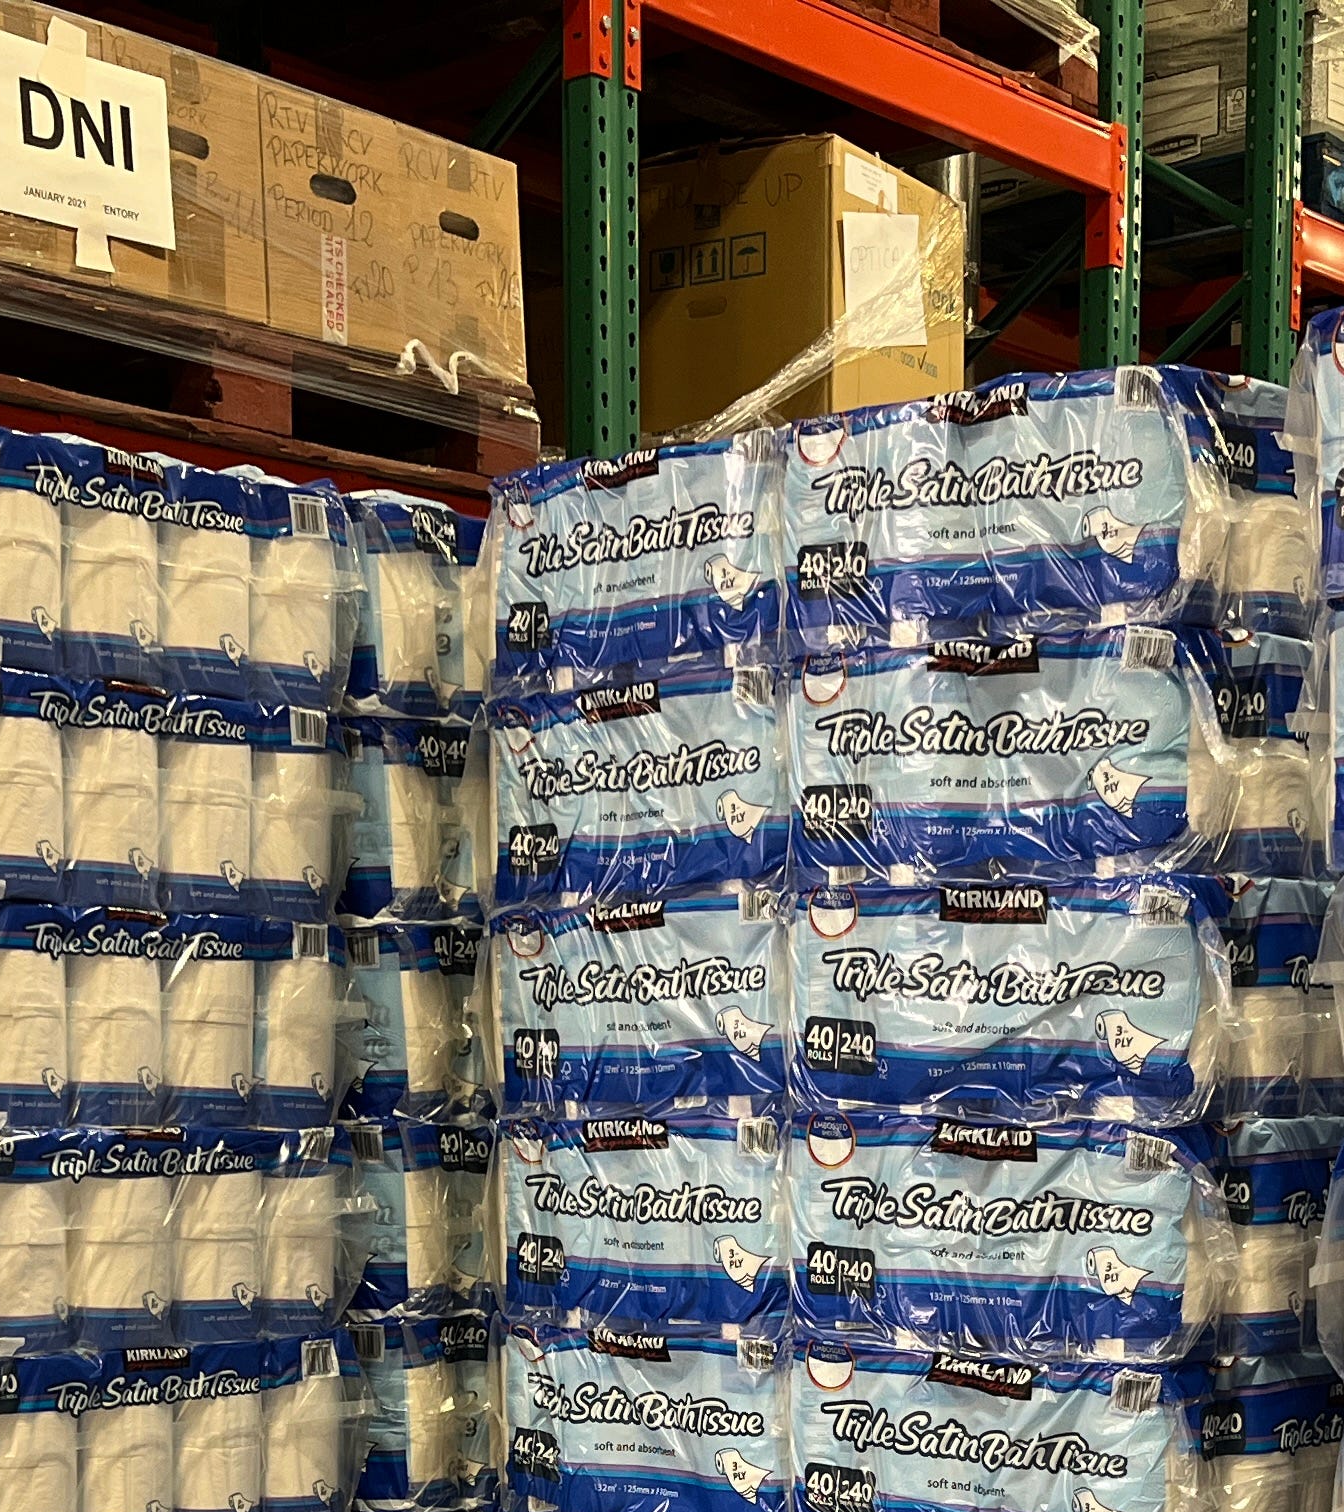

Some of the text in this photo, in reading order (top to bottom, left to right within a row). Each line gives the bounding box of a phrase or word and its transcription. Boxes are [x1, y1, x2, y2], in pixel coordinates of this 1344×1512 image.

[19, 77, 134, 172] DNI
[262, 91, 310, 133] RTV
[266, 135, 383, 196] PAPERWORK
[23, 185, 140, 221] JANUARY 2021 ENTORY
[765, 173, 803, 206] UP
[267, 183, 374, 248] PERIOD 12
[850, 246, 900, 273] OPTICA
[946, 889, 1043, 909] KIRKLAND
[824, 949, 899, 1000] Triple
[807, 1024, 874, 1054] 40 240
[808, 1051, 833, 1061] ROLLS
[1115, 1037, 1133, 1049] PLY
[635, 1183, 761, 1224] Bath Tissue
